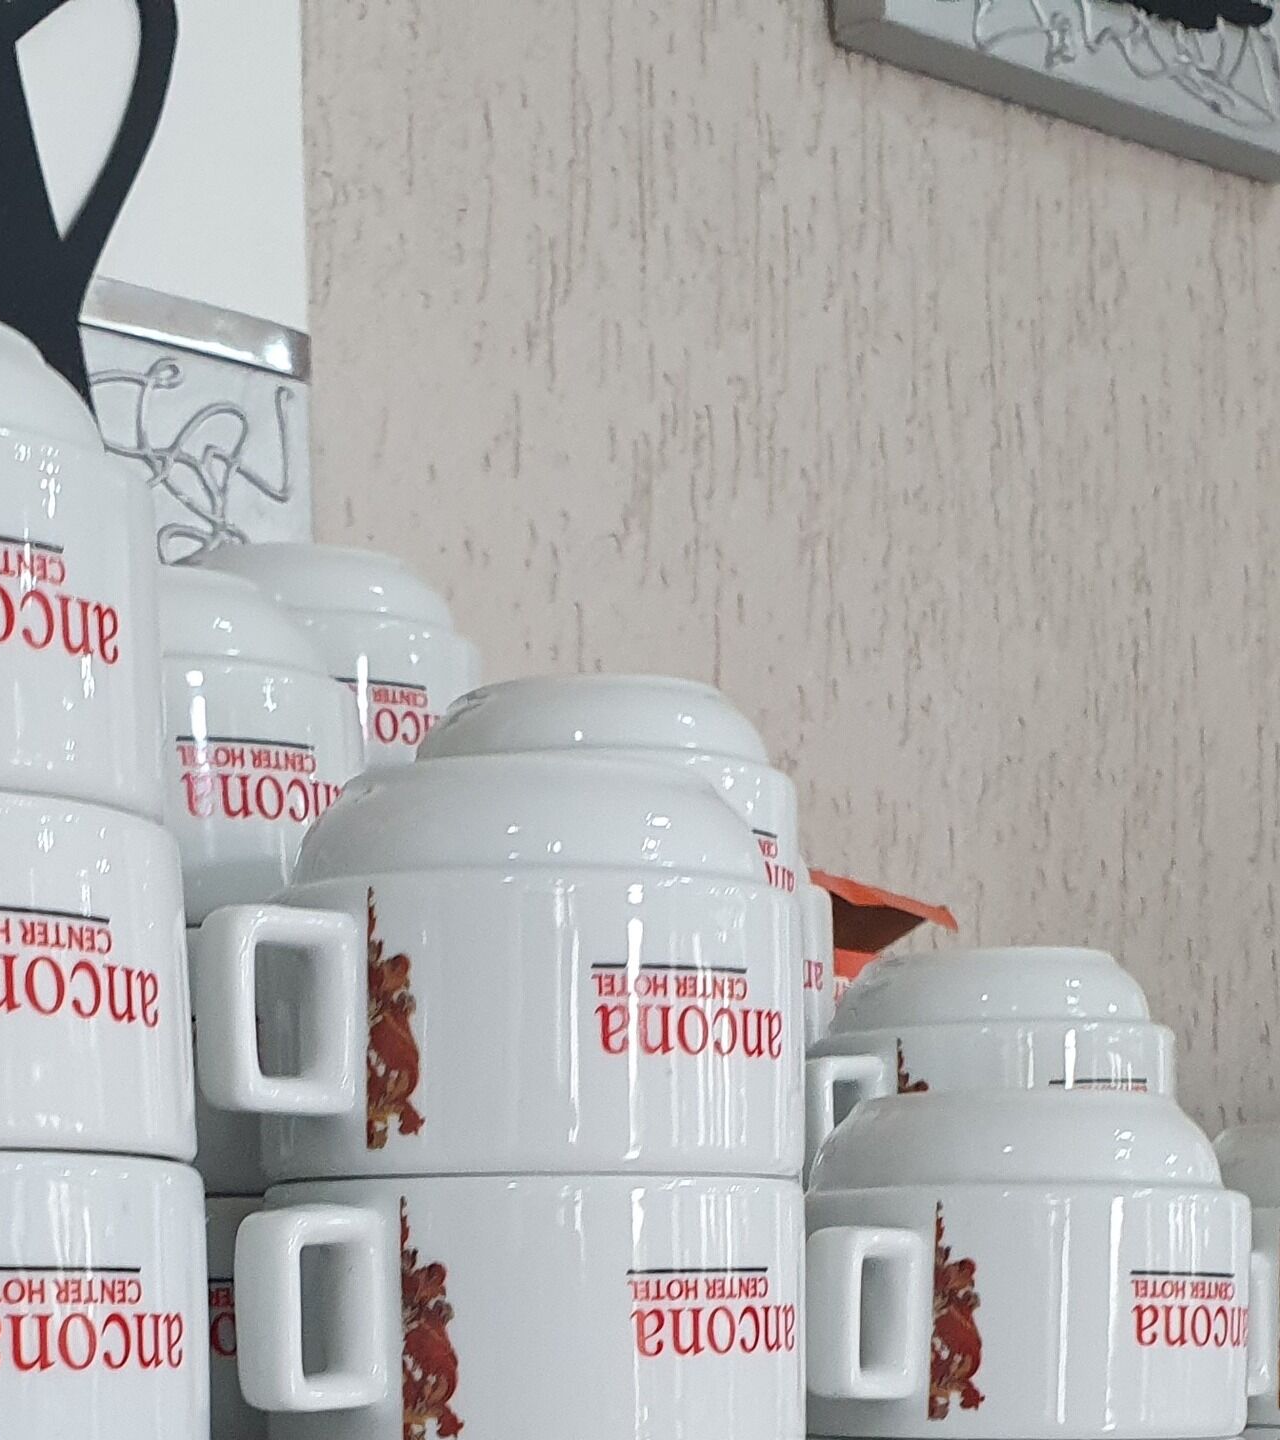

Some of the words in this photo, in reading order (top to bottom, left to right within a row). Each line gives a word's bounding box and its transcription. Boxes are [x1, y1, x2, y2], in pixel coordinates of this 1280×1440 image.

[250, 748, 316, 773] CENTER
[18, 918, 113, 955] CENTER
[591, 974, 668, 998] HOTEL
[674, 976, 747, 1001] CENTER
[594, 1004, 783, 1060] ancona
[54, 1278, 142, 1305] CENTER
[627, 1279, 699, 1301] HOTEL
[705, 1277, 768, 1300] CENTER
[1130, 1279, 1186, 1300] HOTEL
[1190, 1281, 1235, 1302] CENTER
[630, 1303, 796, 1358] ancona
[1131, 1304, 1248, 1349] ancona
